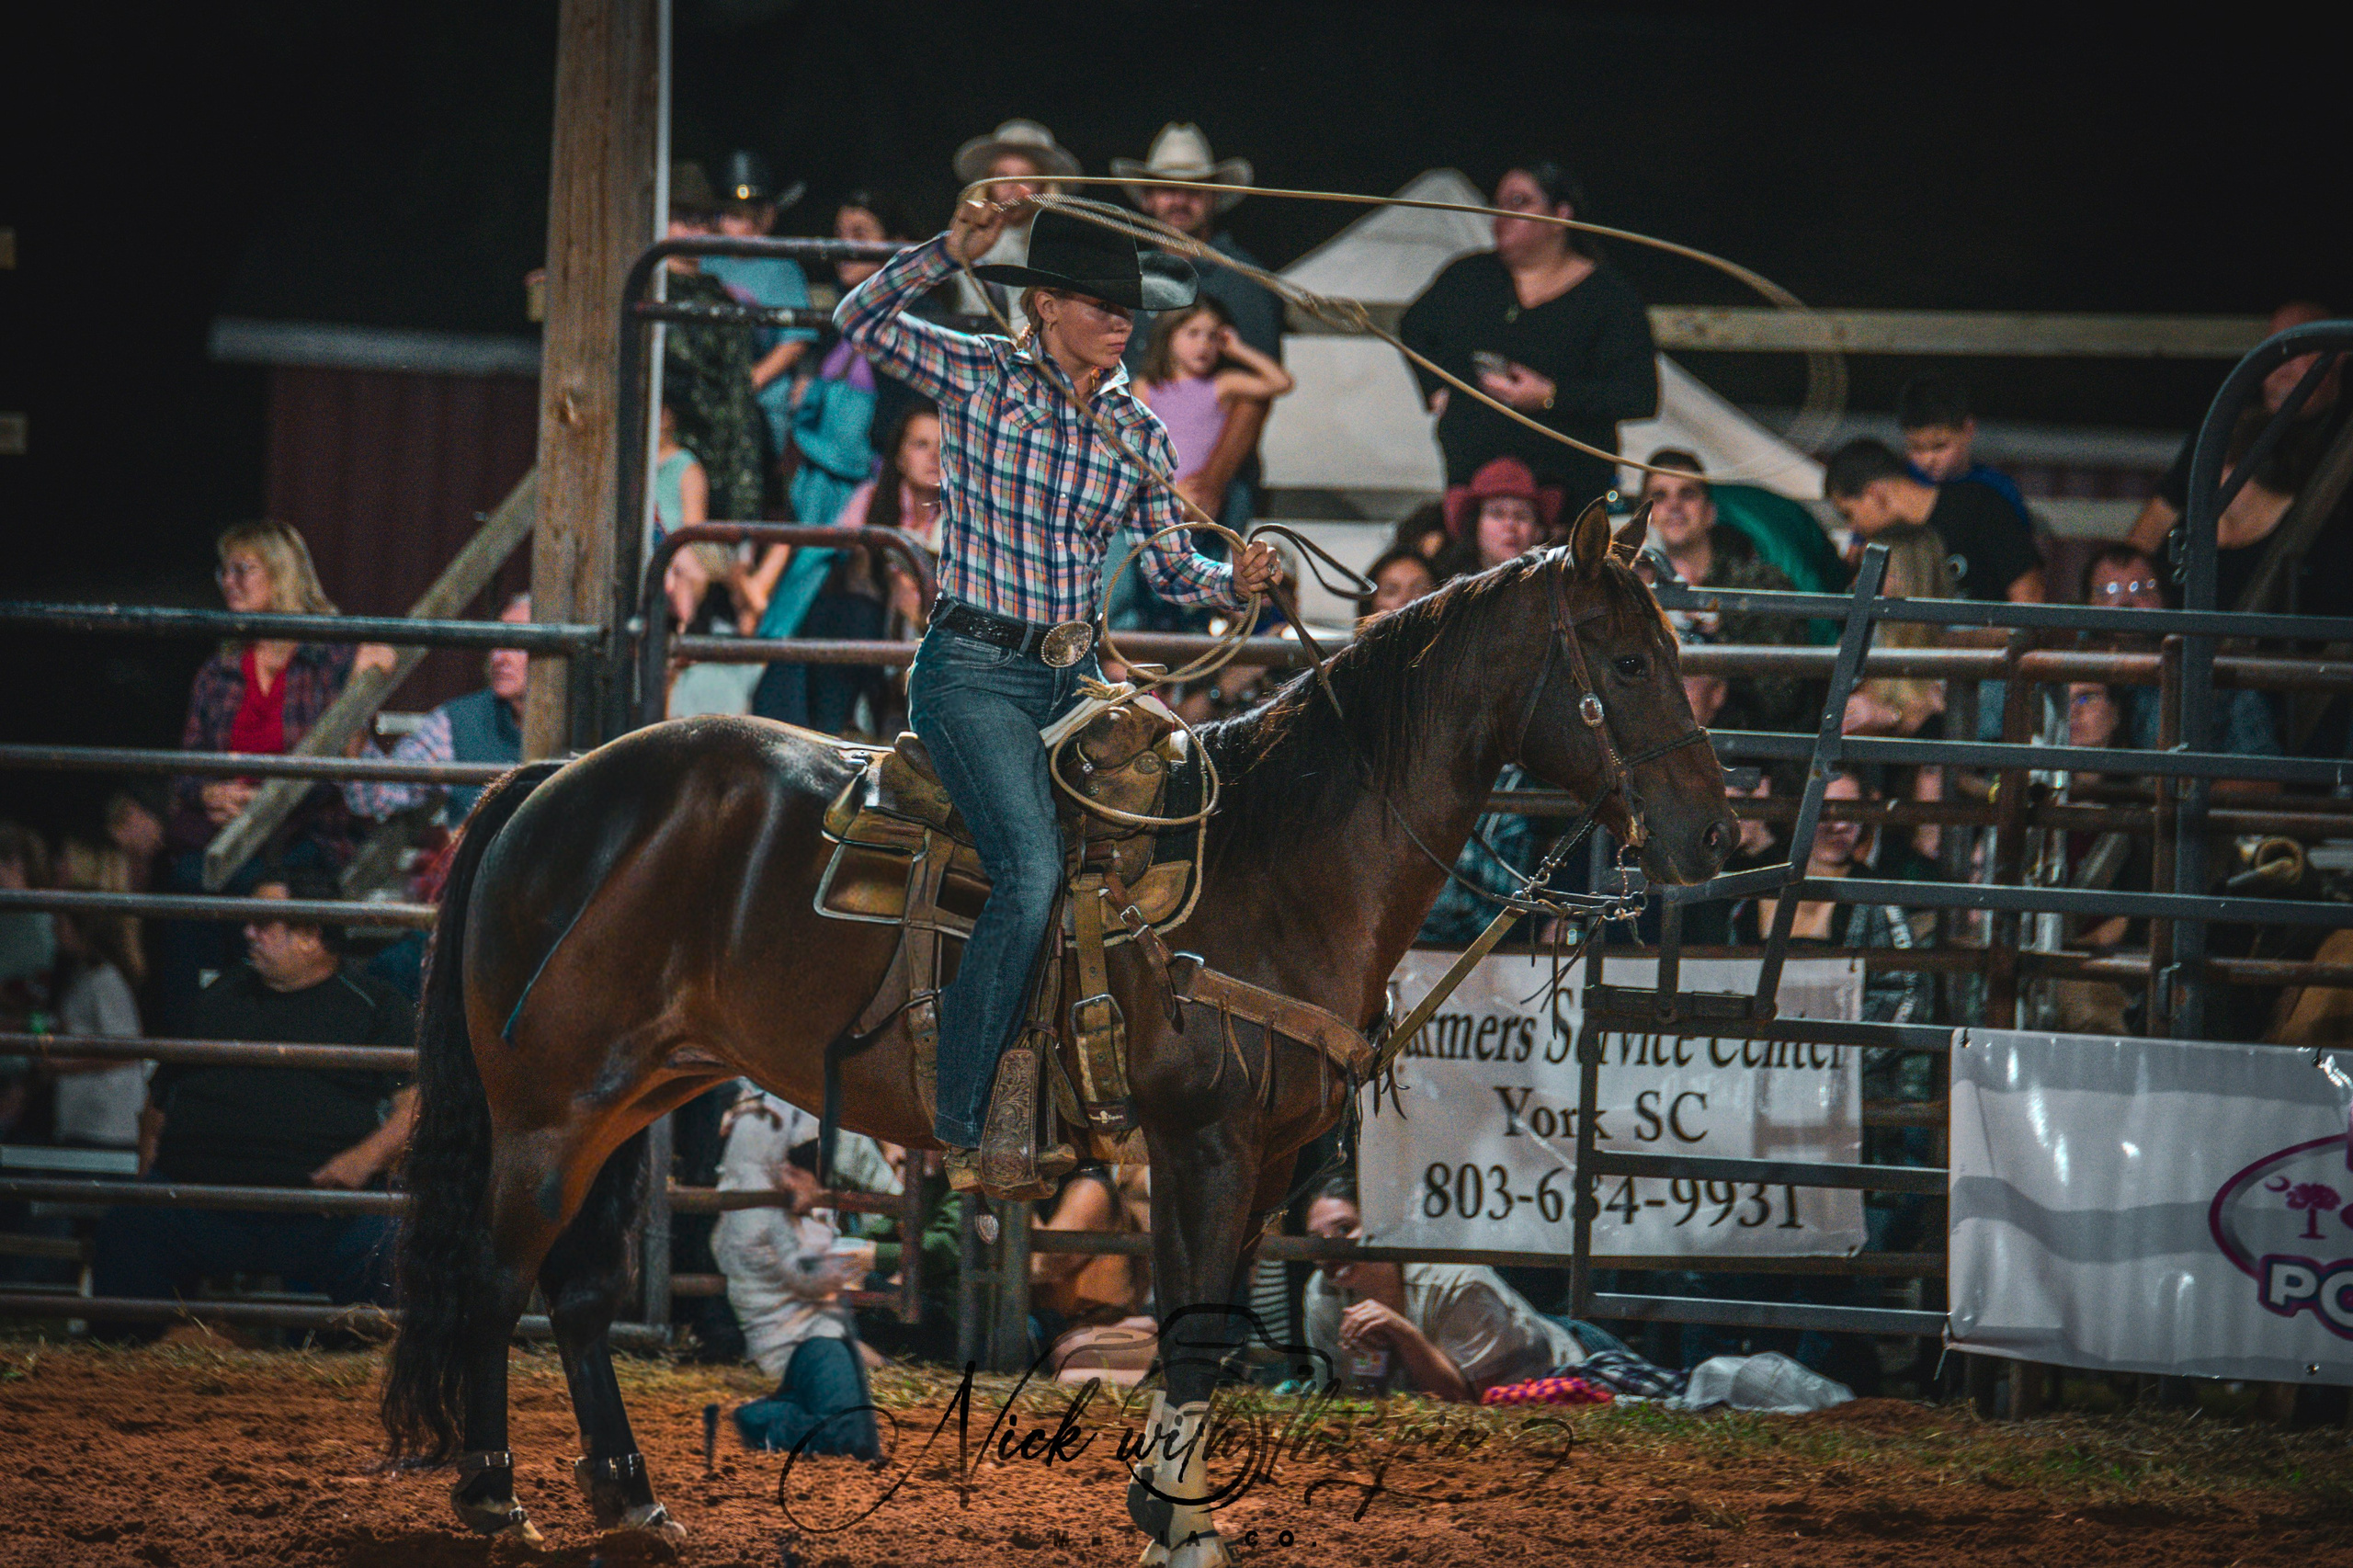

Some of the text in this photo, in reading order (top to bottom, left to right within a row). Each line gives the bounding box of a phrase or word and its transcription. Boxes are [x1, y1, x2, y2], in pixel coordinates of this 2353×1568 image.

[1544, 986, 1695, 1066] Srvice
[1494, 1085, 1709, 1143] York SC
